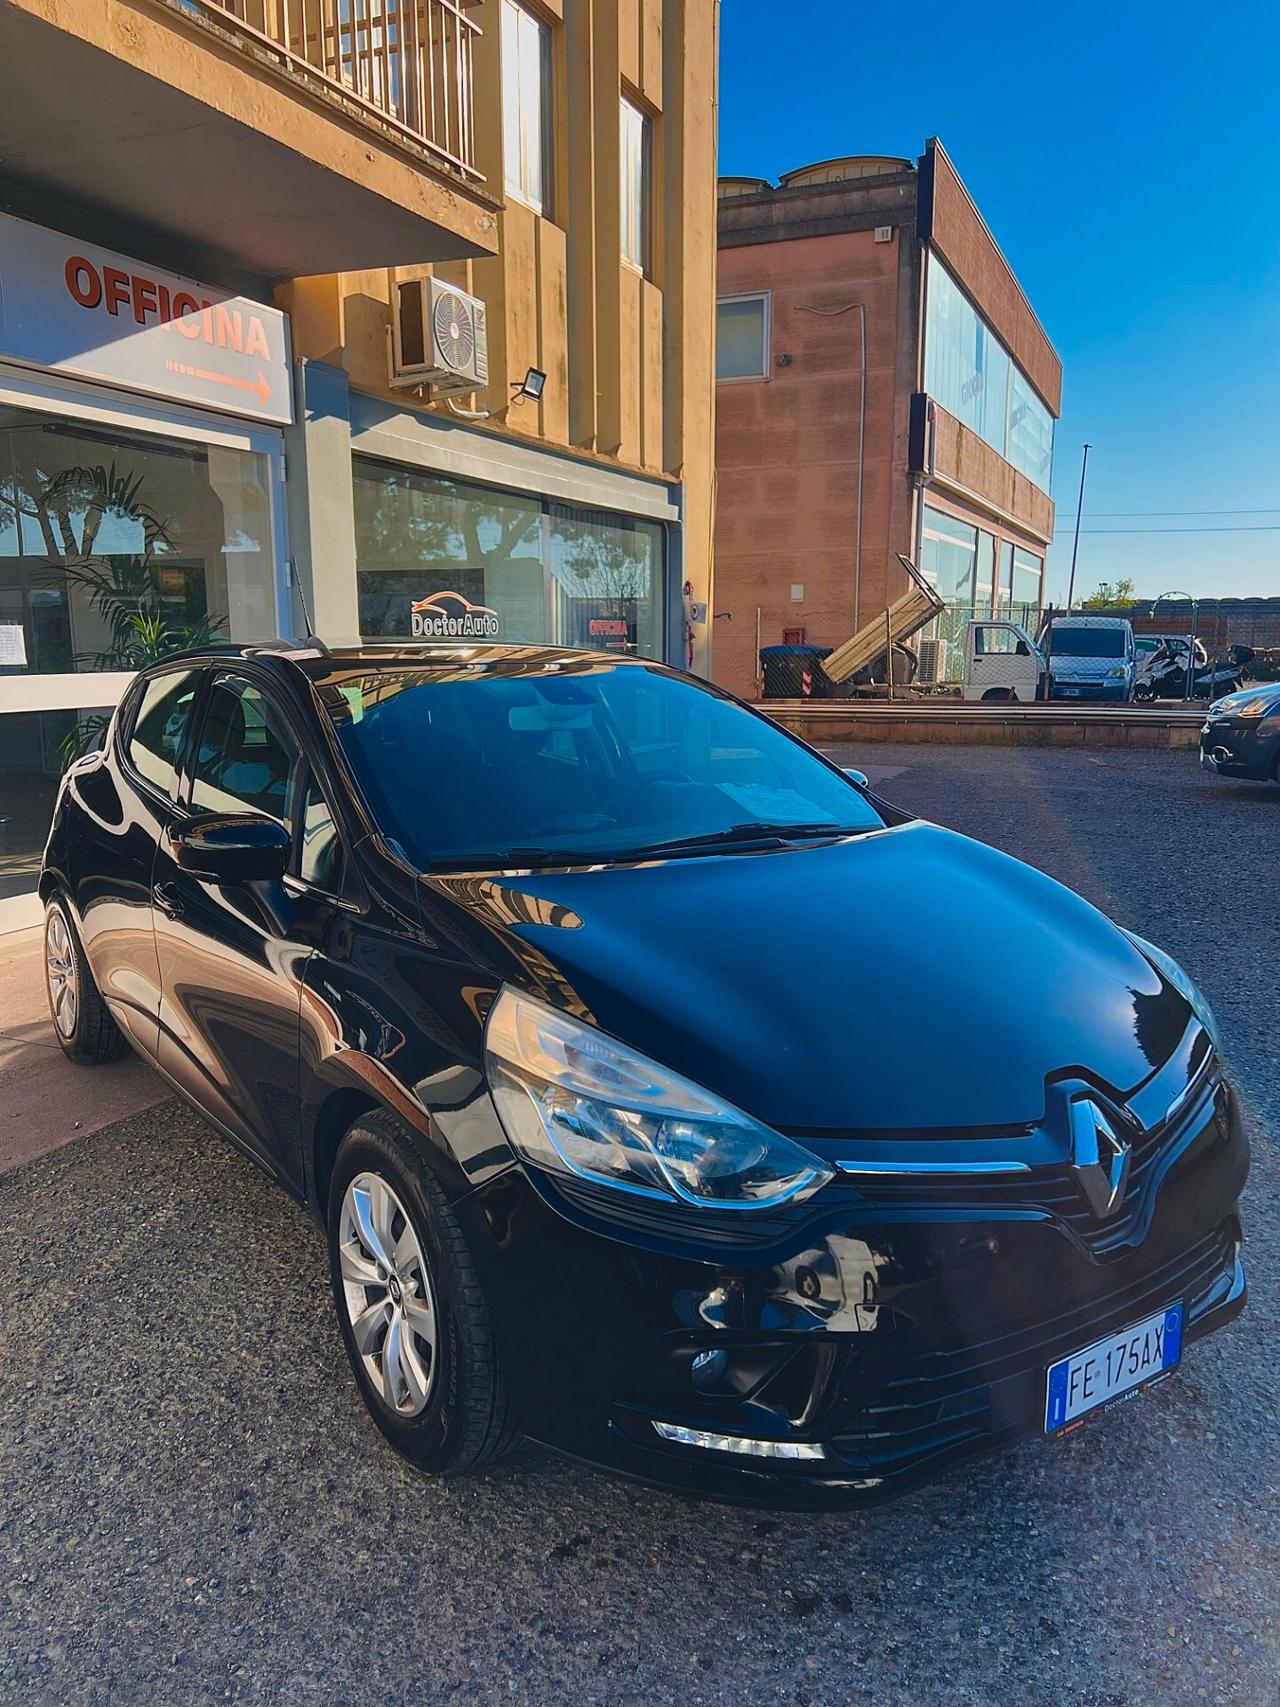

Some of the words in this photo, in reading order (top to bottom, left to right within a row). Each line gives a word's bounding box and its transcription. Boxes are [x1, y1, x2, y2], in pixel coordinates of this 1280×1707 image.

[65, 256, 271, 361] OFFICINA
[411, 613, 499, 636] DoctorAuto
[1069, 1358, 1097, 1408] FE
[1106, 1324, 1164, 1387] 175AX
